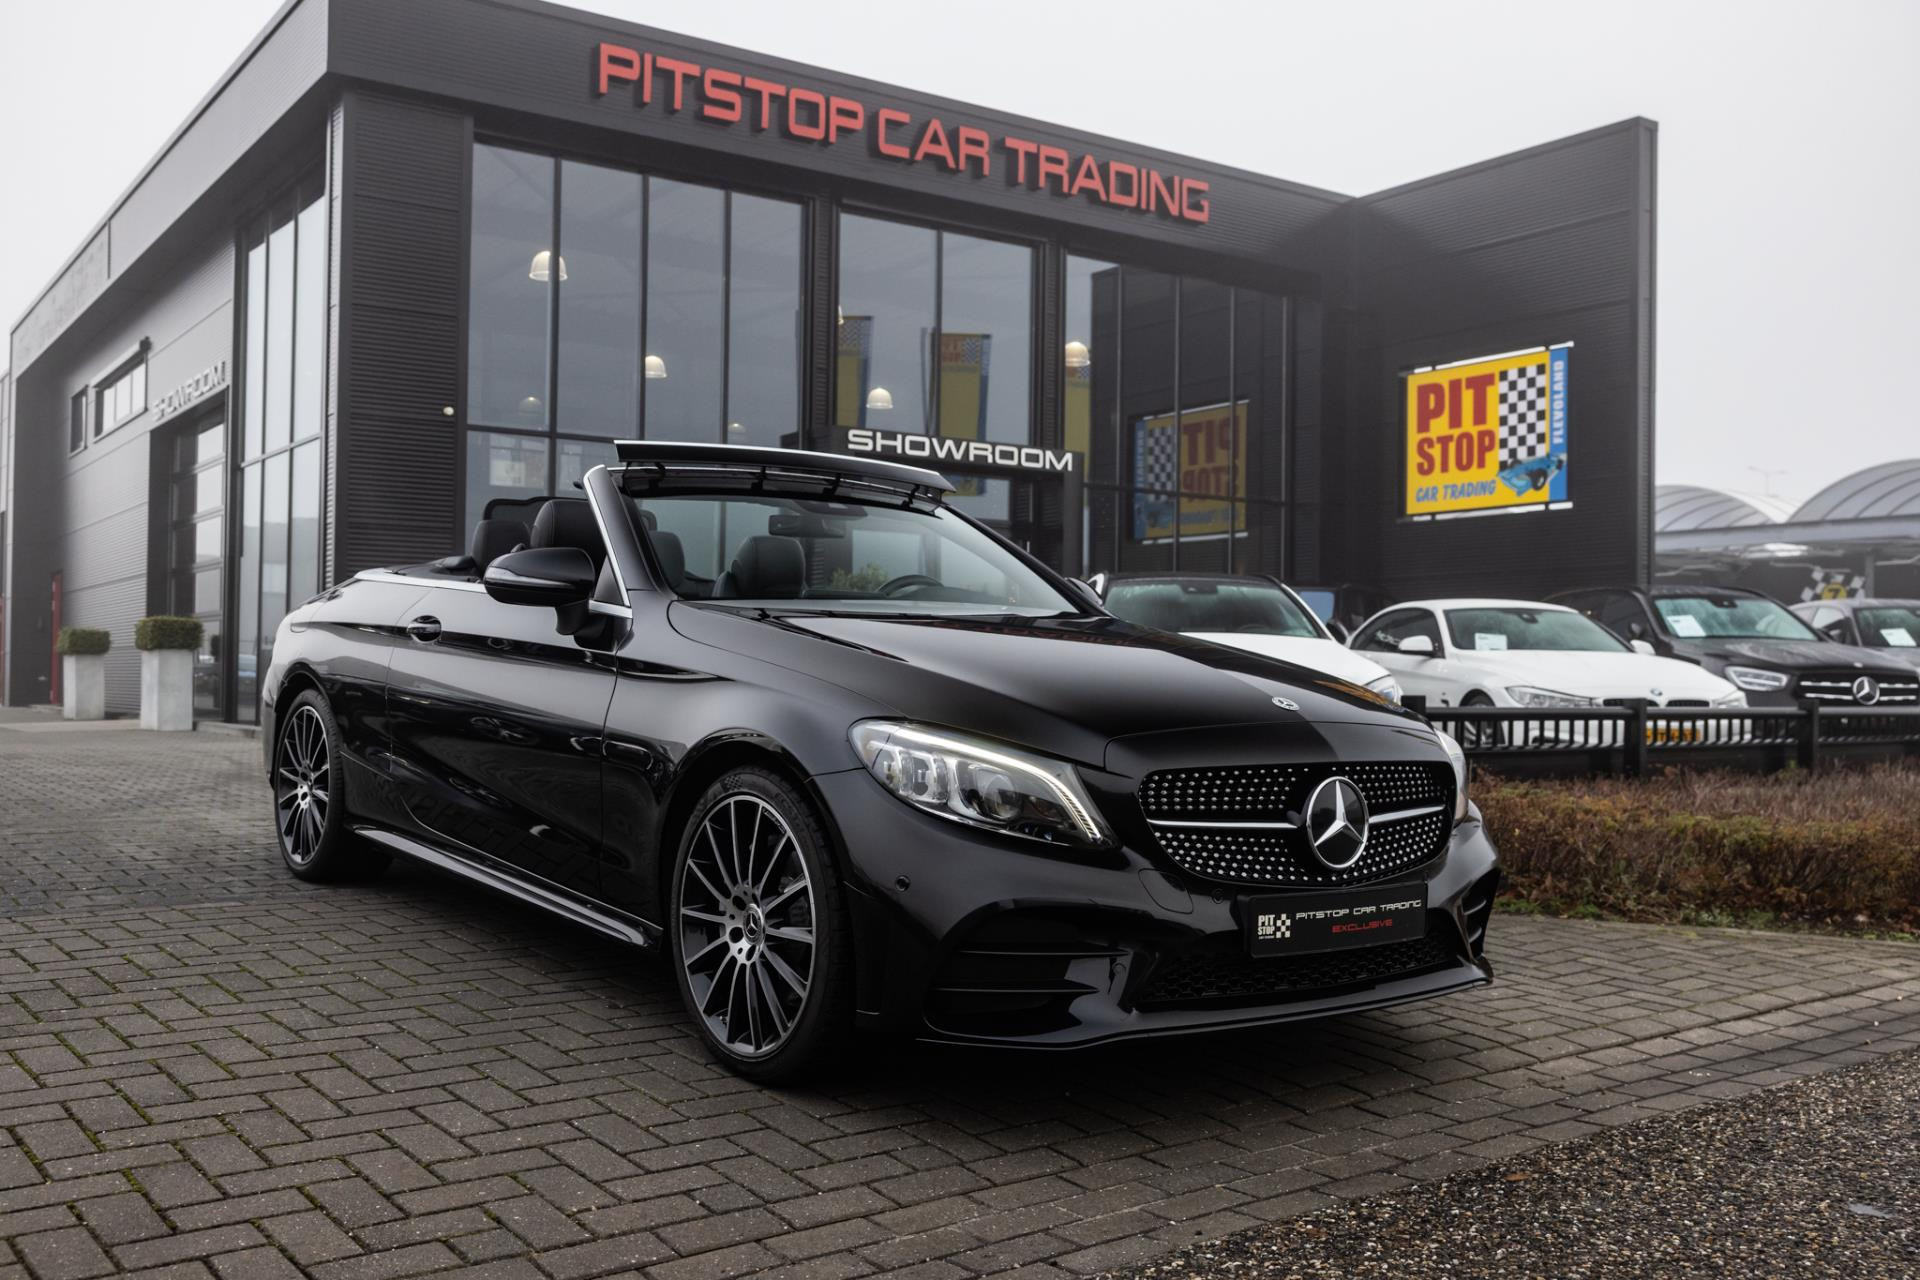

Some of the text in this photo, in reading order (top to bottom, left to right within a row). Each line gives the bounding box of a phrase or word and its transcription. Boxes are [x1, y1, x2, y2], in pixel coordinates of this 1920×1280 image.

[599, 42, 1209, 222] PITSTOP CAR TRADING
[1416, 373, 1496, 434] PIT
[847, 429, 1074, 472] SHOWROOM
[1416, 429, 1496, 476] STOP
[1415, 480, 1497, 502] CAR TRADING
[1258, 914, 1276, 926] PIT
[1296, 900, 1422, 920] PITSTOP CAR TRADING
[1257, 926, 1275, 935] STOP
[1332, 919, 1393, 933] EXCLUSIVE
